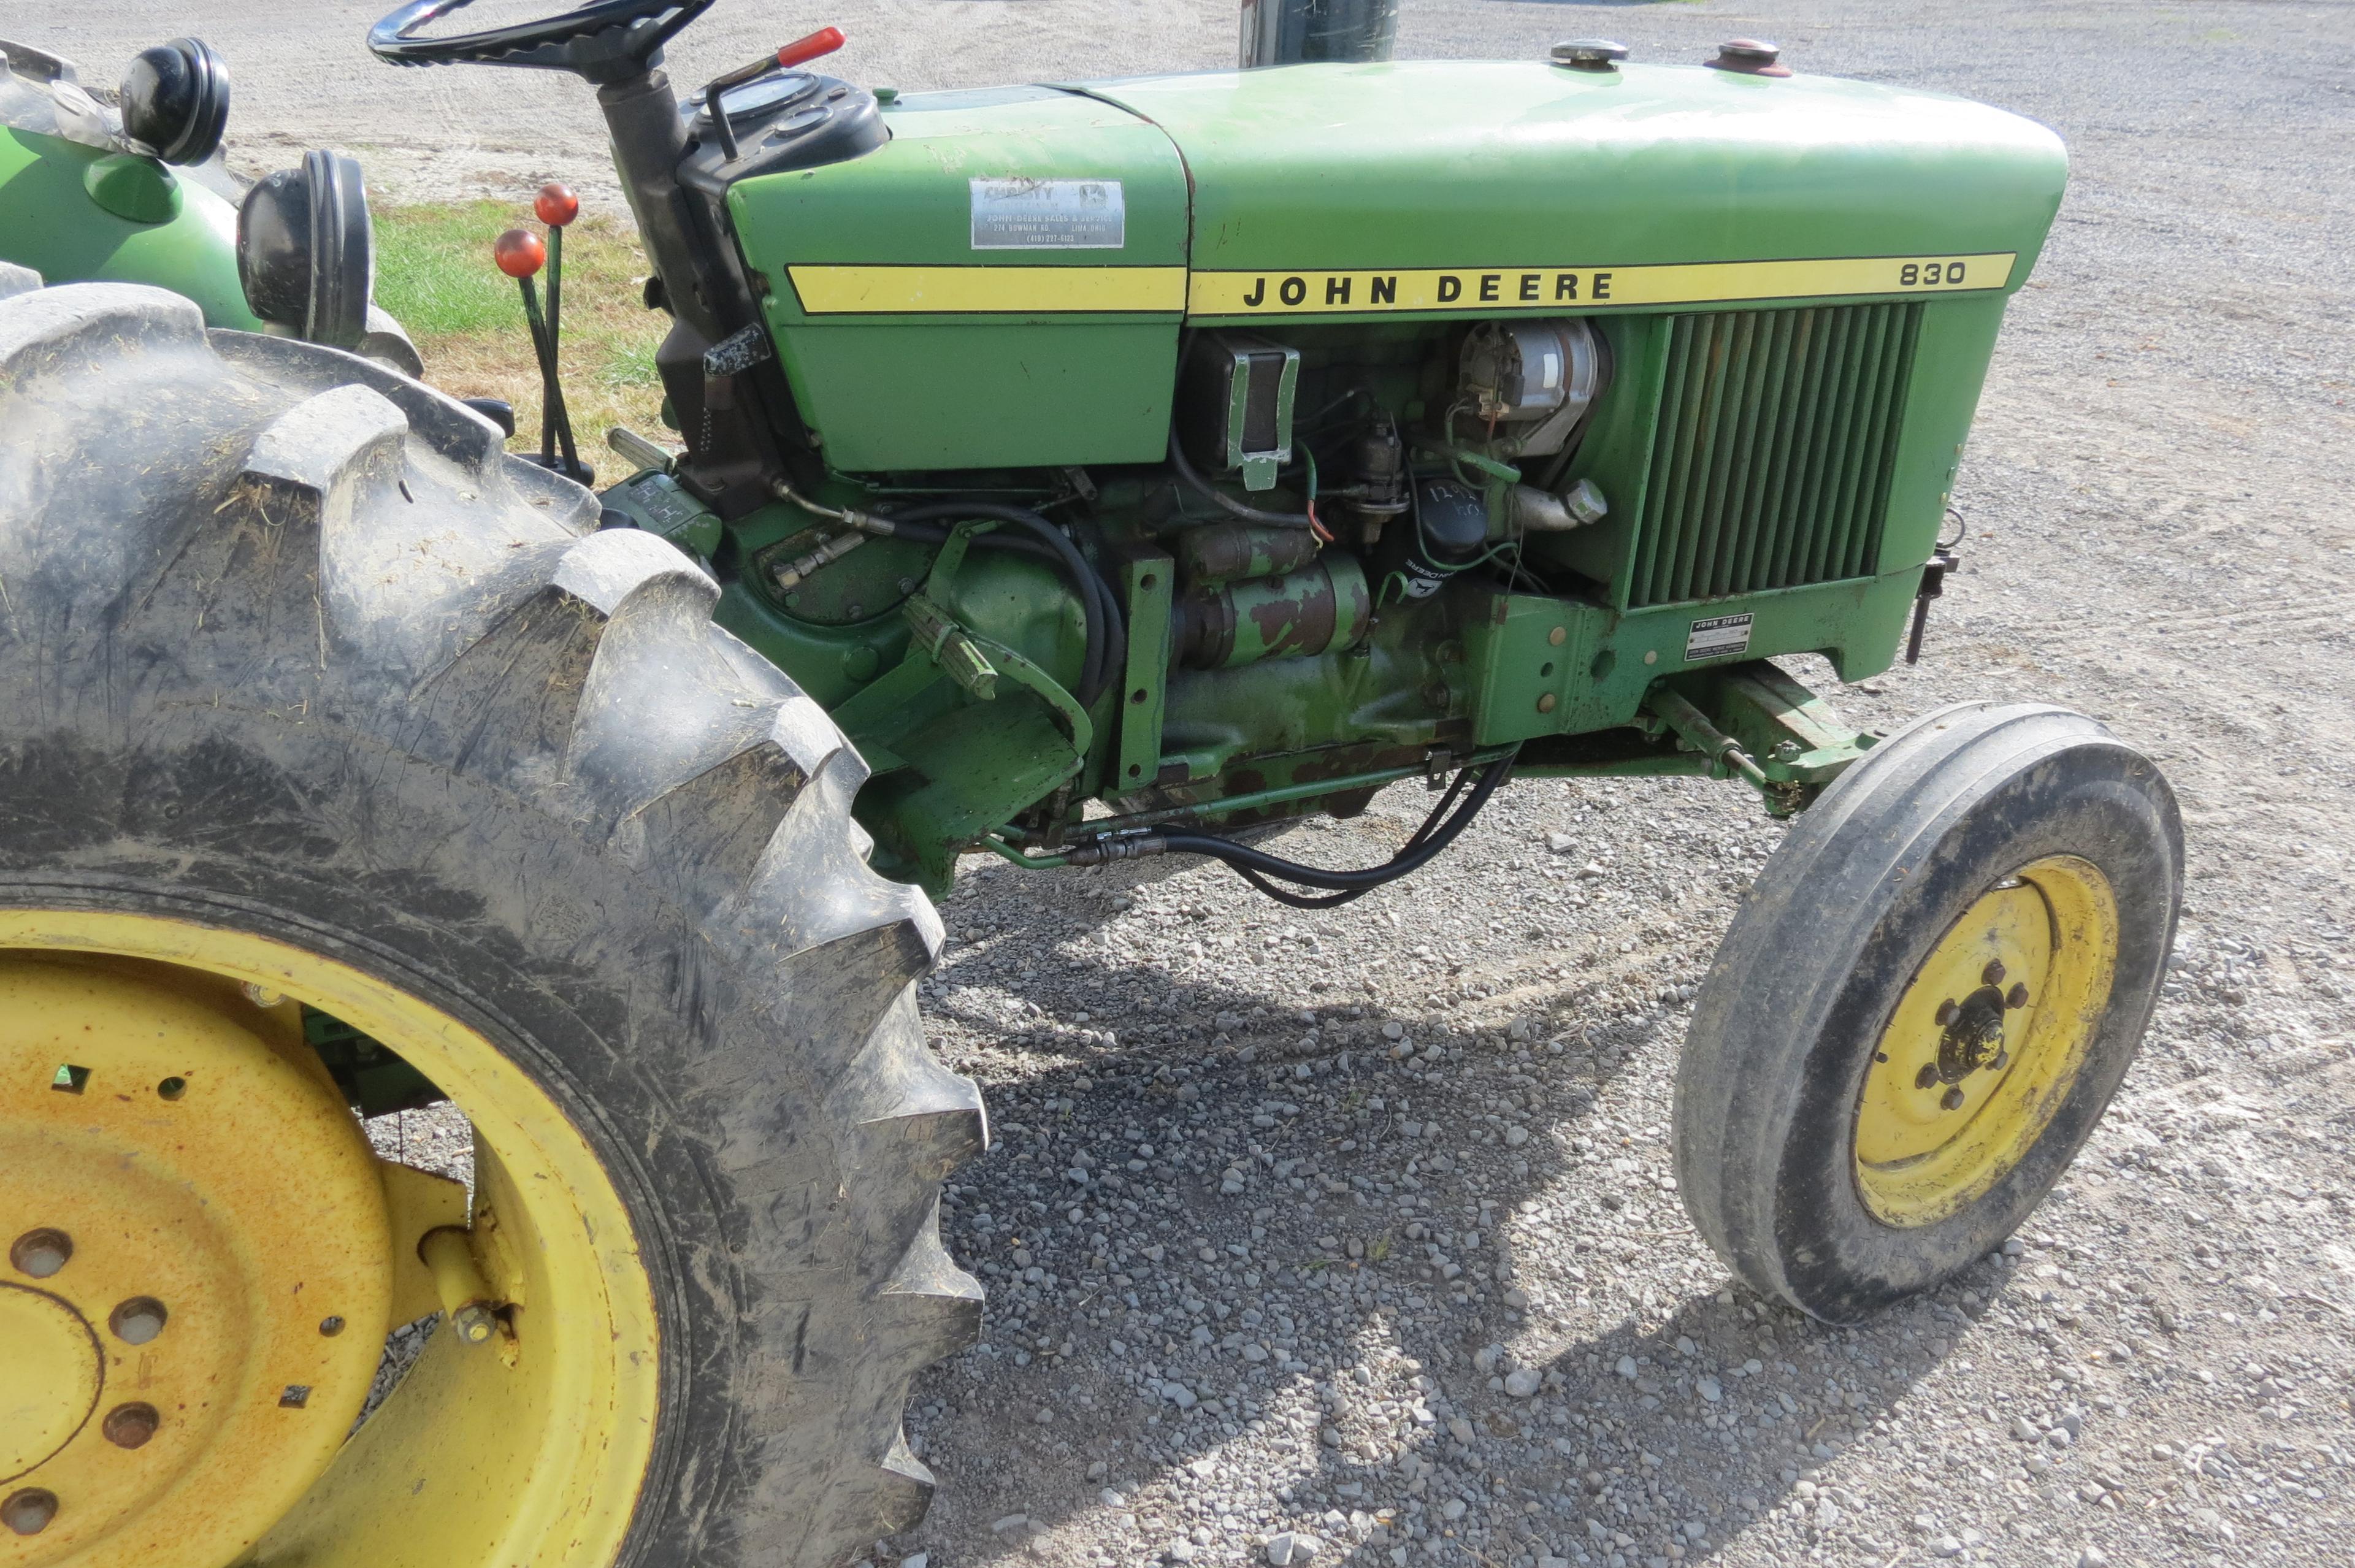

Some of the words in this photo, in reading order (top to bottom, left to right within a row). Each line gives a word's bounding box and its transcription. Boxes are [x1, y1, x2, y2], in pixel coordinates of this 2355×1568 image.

[1027, 234, 1045, 243] (419)
[1899, 261, 1966, 286] 830
[1243, 276, 1397, 307] JOHN
[1437, 272, 1614, 303] DEERE
[1405, 559, 1439, 579] DEERE
[1721, 616, 1749, 625] DEERE
